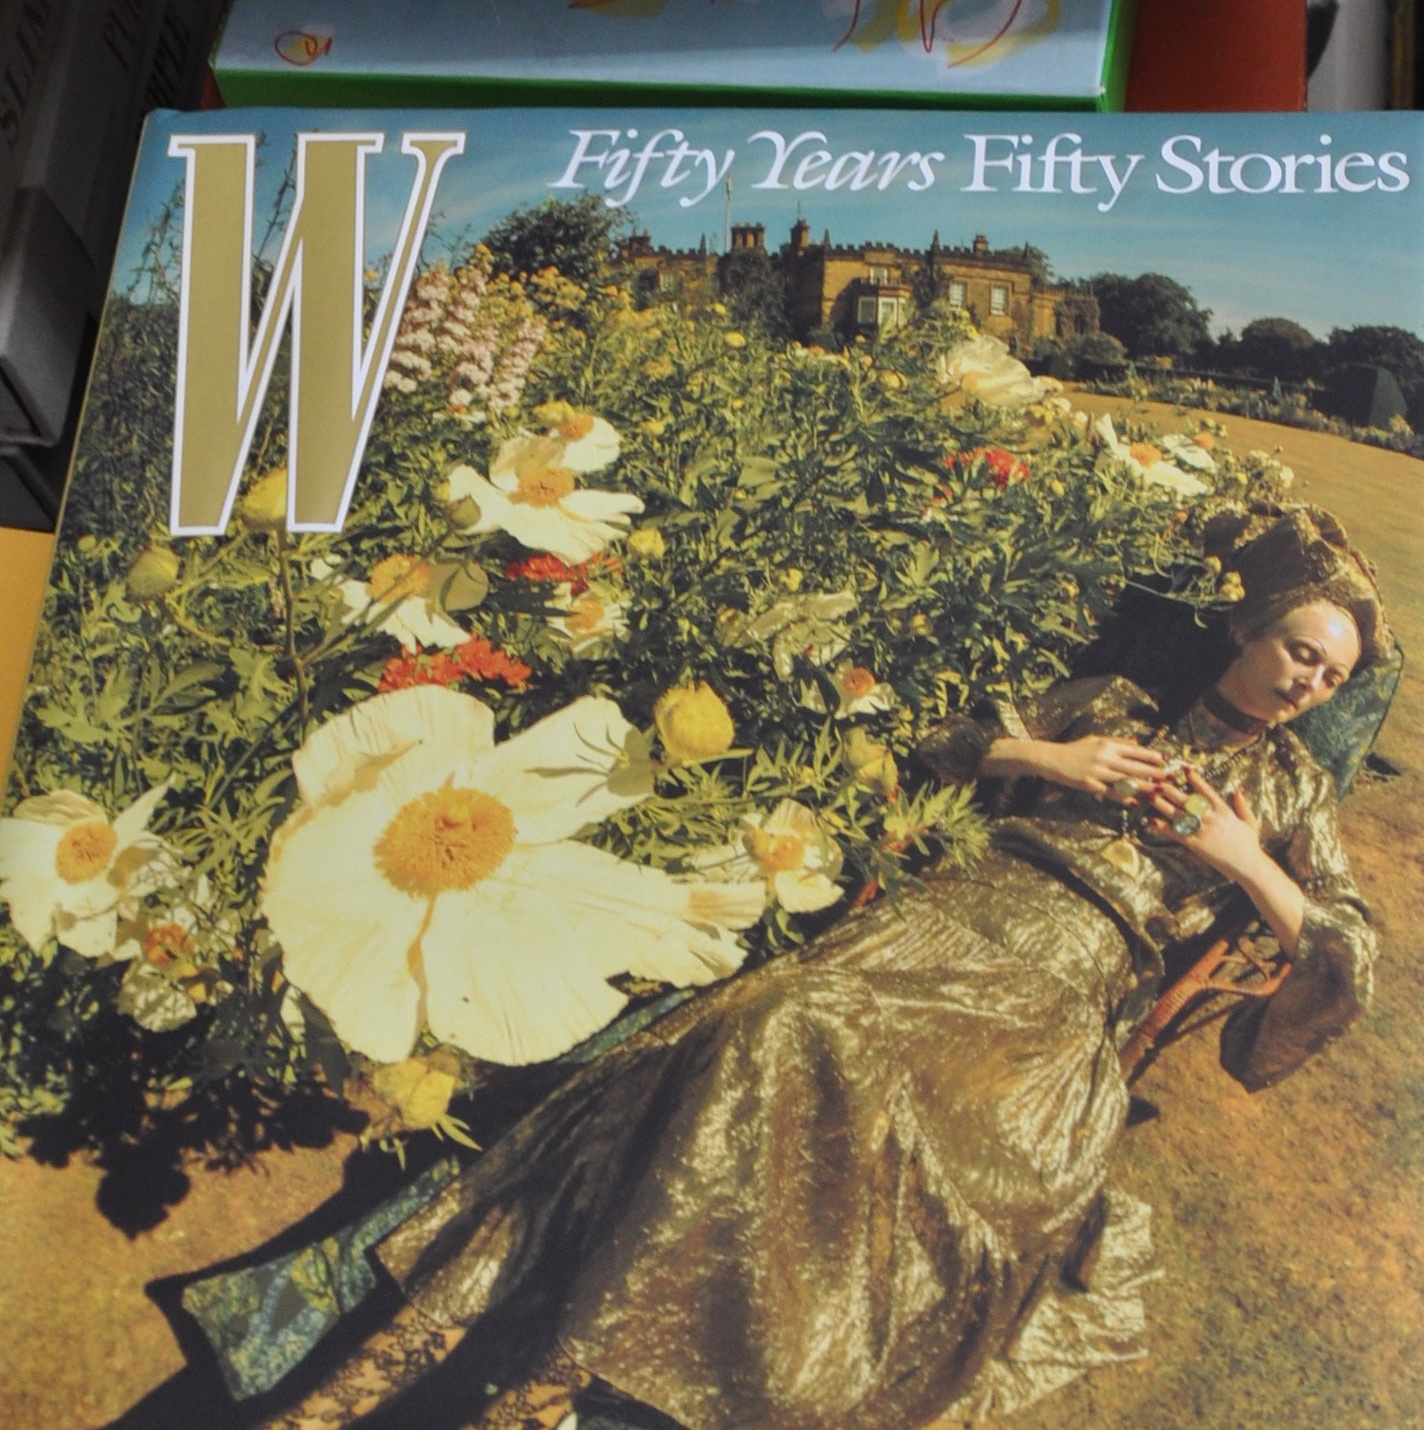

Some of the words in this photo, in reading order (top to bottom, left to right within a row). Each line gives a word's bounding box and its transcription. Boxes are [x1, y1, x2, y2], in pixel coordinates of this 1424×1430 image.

[547, 127, 734, 207] Fifty
[748, 128, 945, 193] Years
[962, 133, 1141, 210] Fifty
[1156, 133, 1410, 194] Stories
[168, 132, 466, 537] W
